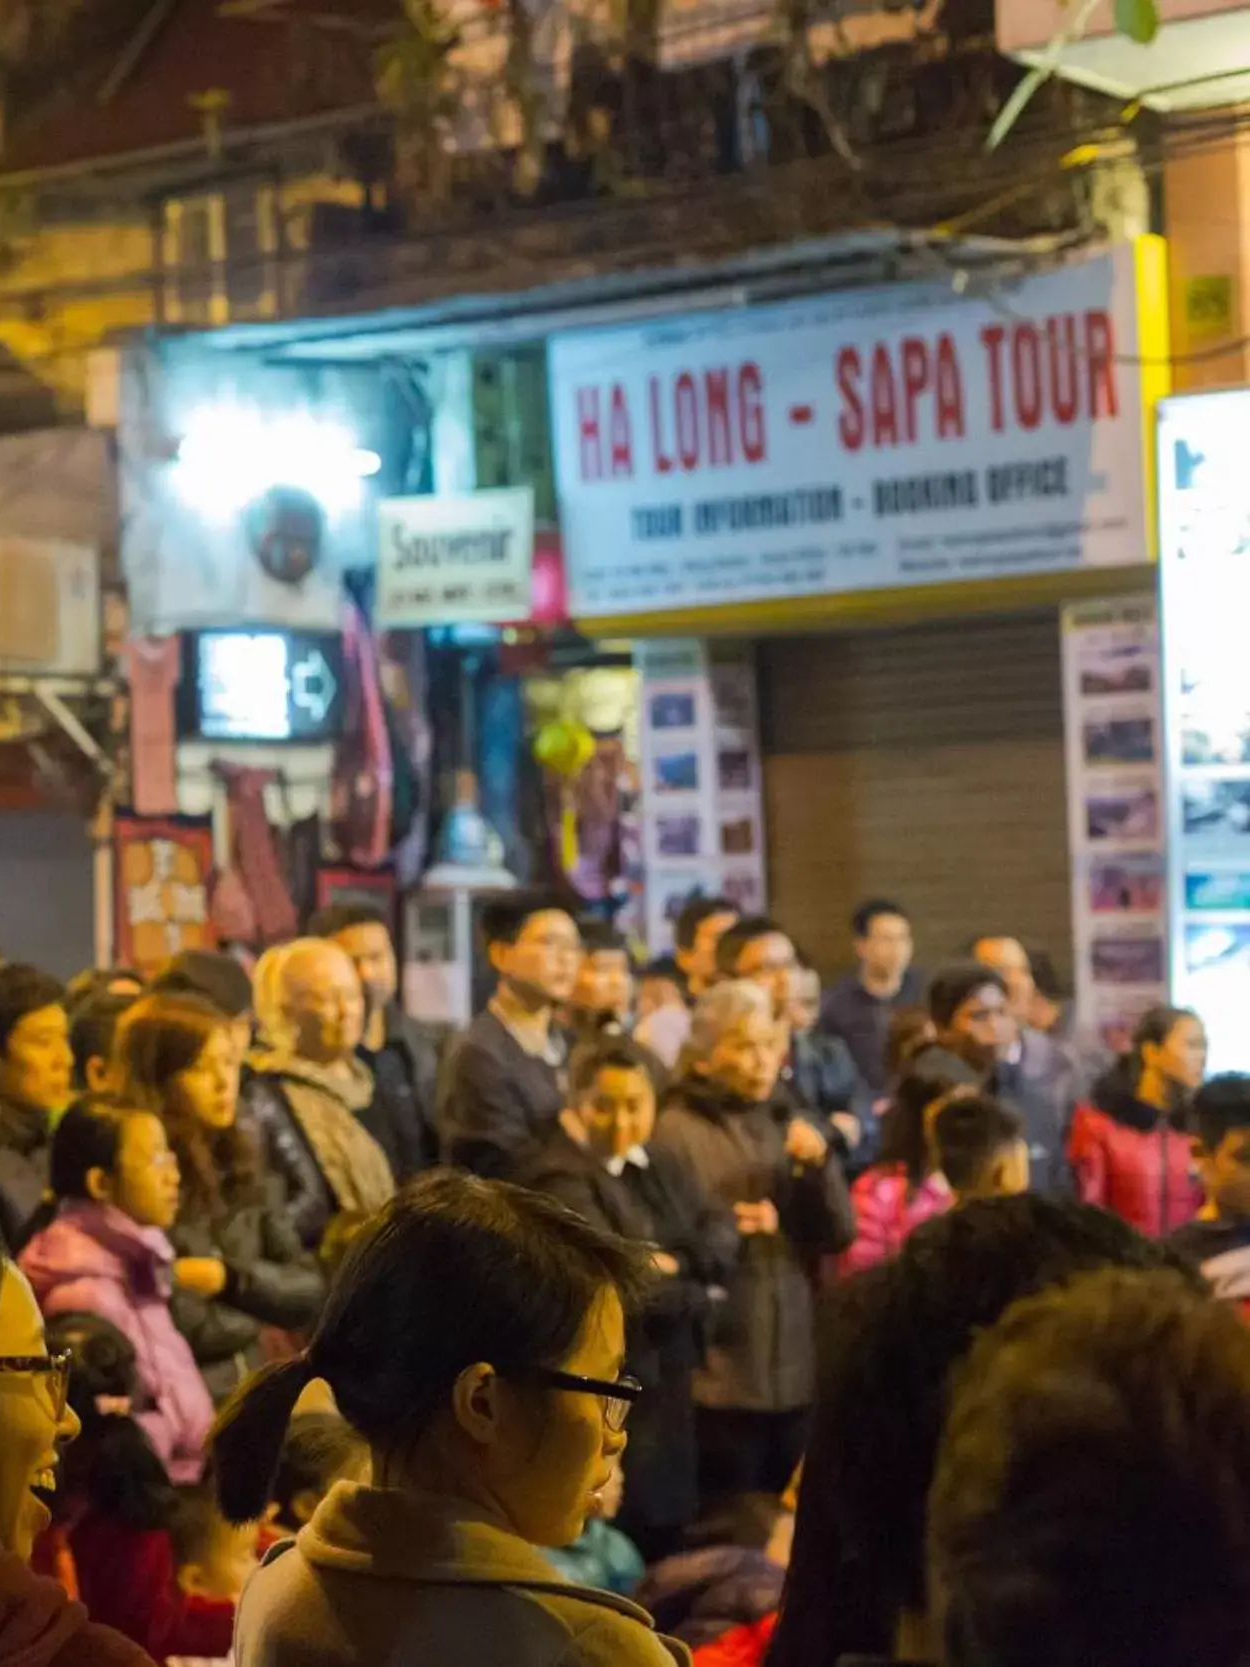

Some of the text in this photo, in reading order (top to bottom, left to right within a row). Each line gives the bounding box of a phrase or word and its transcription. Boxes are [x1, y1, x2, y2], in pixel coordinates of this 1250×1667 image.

[576, 382, 635, 485] HA
[648, 361, 768, 475] LONG
[835, 331, 966, 453] SAPA
[980, 308, 1120, 434] TOUR
[631, 503, 683, 540] TOUR
[695, 485, 844, 536] INFORMATION
[873, 468, 978, 519] BOOKING
[985, 455, 1069, 507] OFFICE
[391, 522, 514, 572] Souvenir
